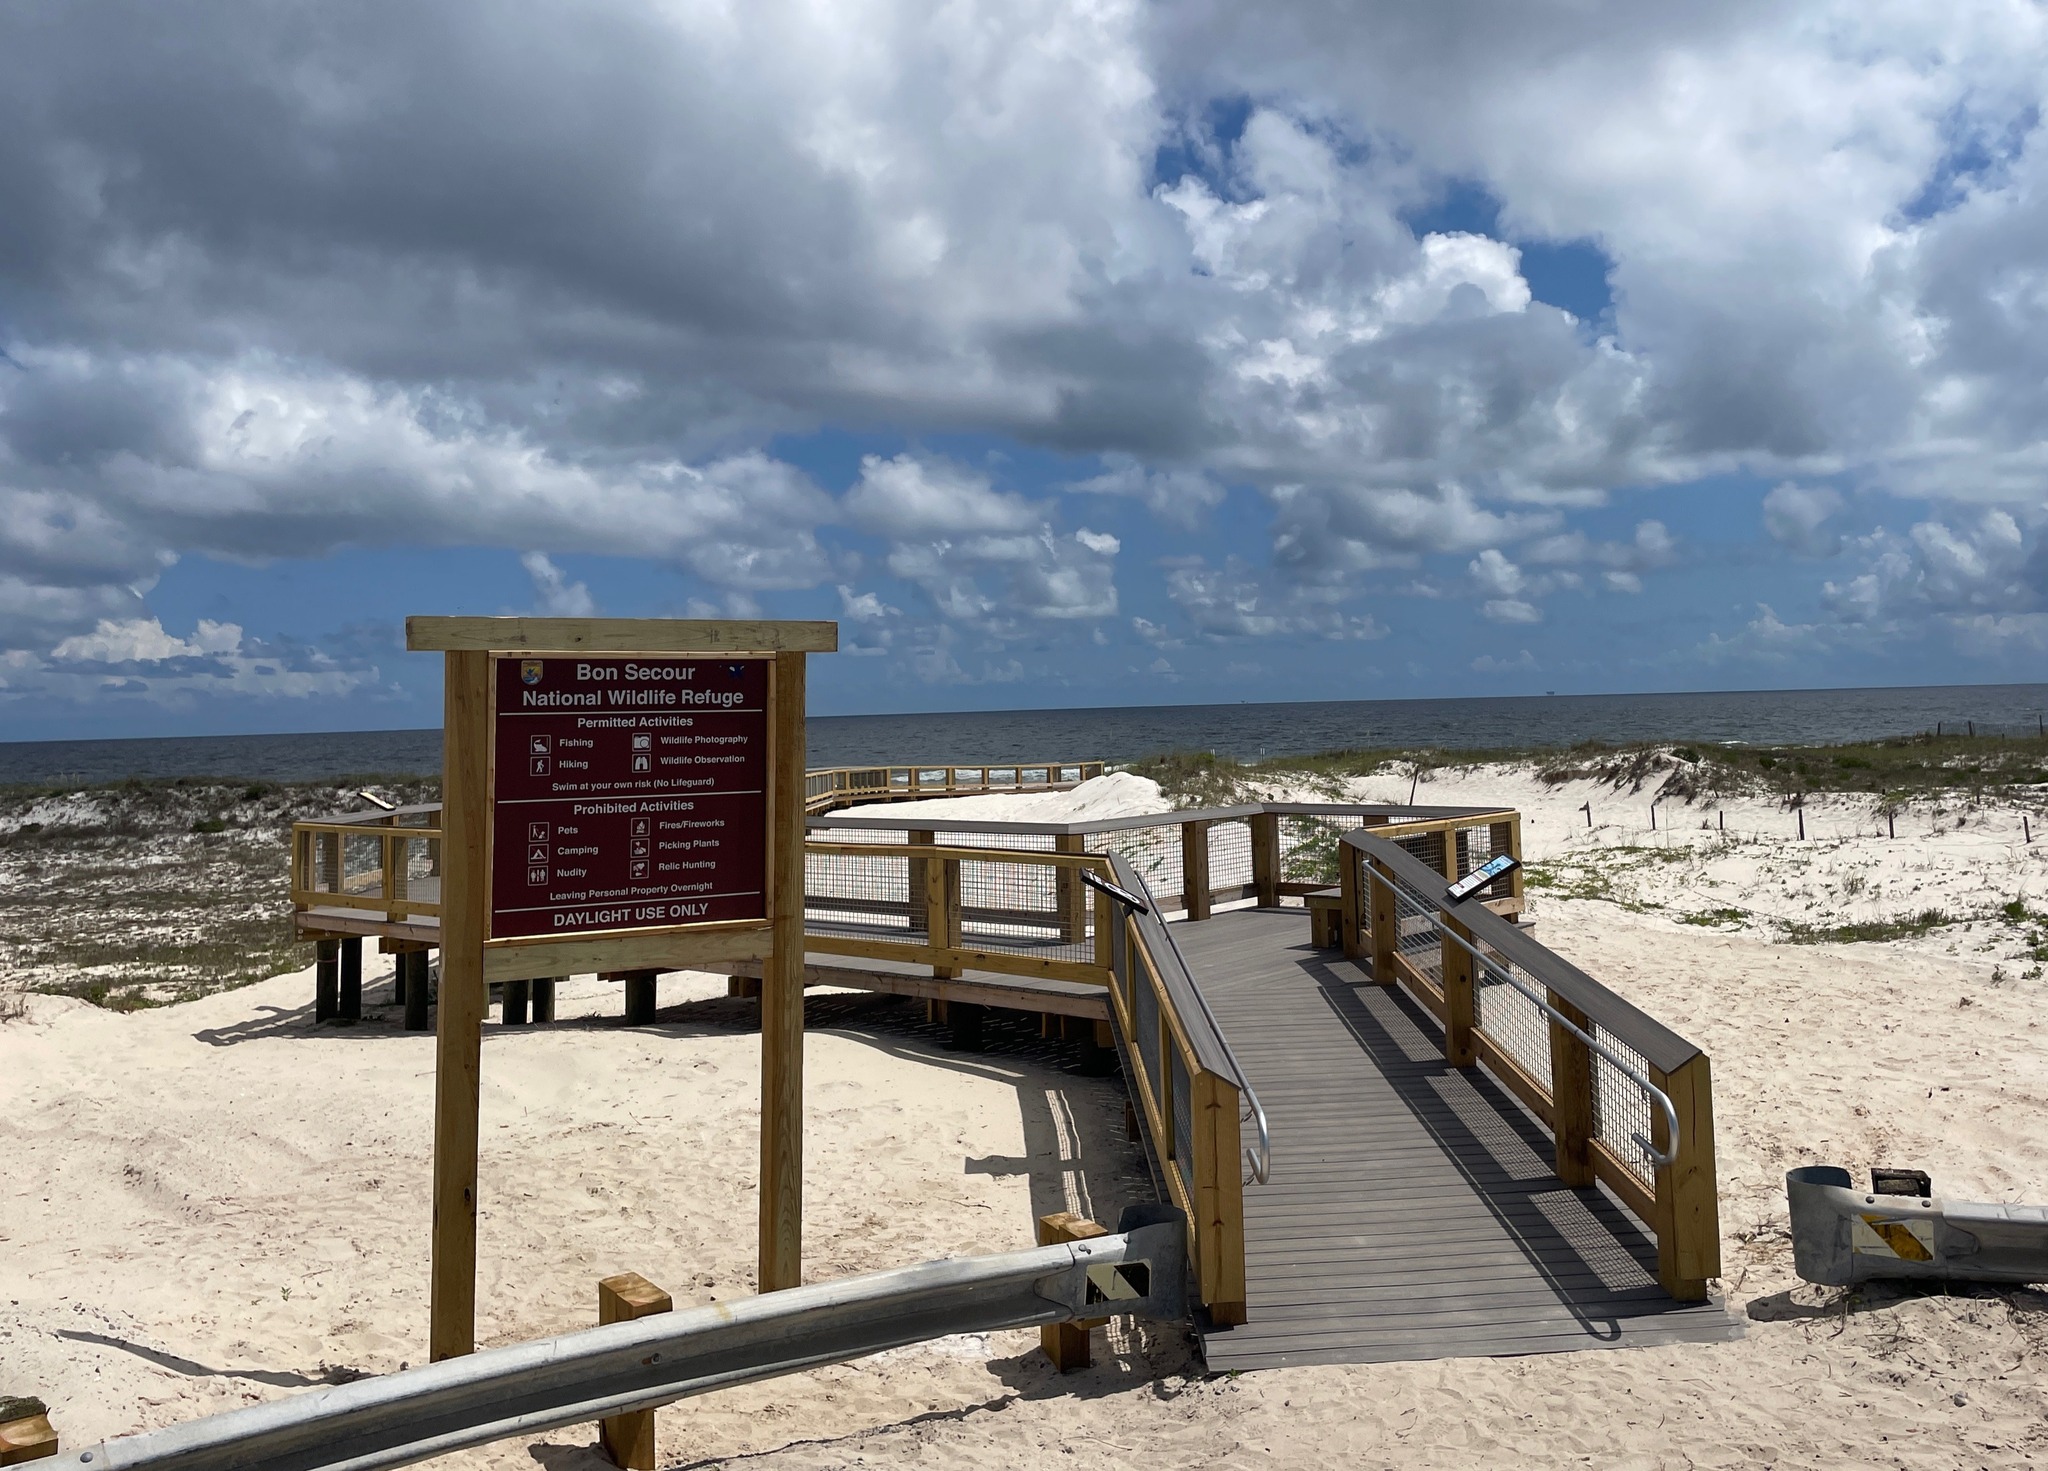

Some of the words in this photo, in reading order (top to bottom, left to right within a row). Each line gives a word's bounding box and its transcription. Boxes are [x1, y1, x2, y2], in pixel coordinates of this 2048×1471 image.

[577, 664, 617, 680] Bon
[625, 664, 695, 680] Secour
[523, 690, 601, 706] National
[608, 690, 676, 704] Wildlife
[682, 690, 743, 707] Refuge
[578, 717, 635, 727] Permitted
[639, 716, 693, 726] Activities
[560, 739, 593, 748] Fishing
[661, 736, 692, 744] Wildlife
[695, 735, 748, 744] Photography
[695, 755, 744, 763] Observation
[559, 760, 588, 769] Hiking
[553, 783, 577, 791] Swim
[654, 780, 669, 788] (No
[672, 778, 714, 787] Lifeguard)
[574, 803, 636, 815] Prohibited
[640, 801, 694, 812] Activities
[660, 819, 724, 829] Fires/Fireworks
[659, 841, 690, 850] Picking
[558, 846, 598, 855] Camping
[659, 862, 680, 870] Relic
[683, 861, 715, 869] Hunting
[557, 868, 586, 877] Nudity
[550, 891, 586, 900] Leaving
[589, 888, 628, 897] Personal
[631, 886, 668, 895] Property
[671, 882, 712, 892] Overnight
[554, 909, 631, 926] DAYLIGHT
[636, 906, 665, 920] USE
[670, 903, 708, 917] ONLY
